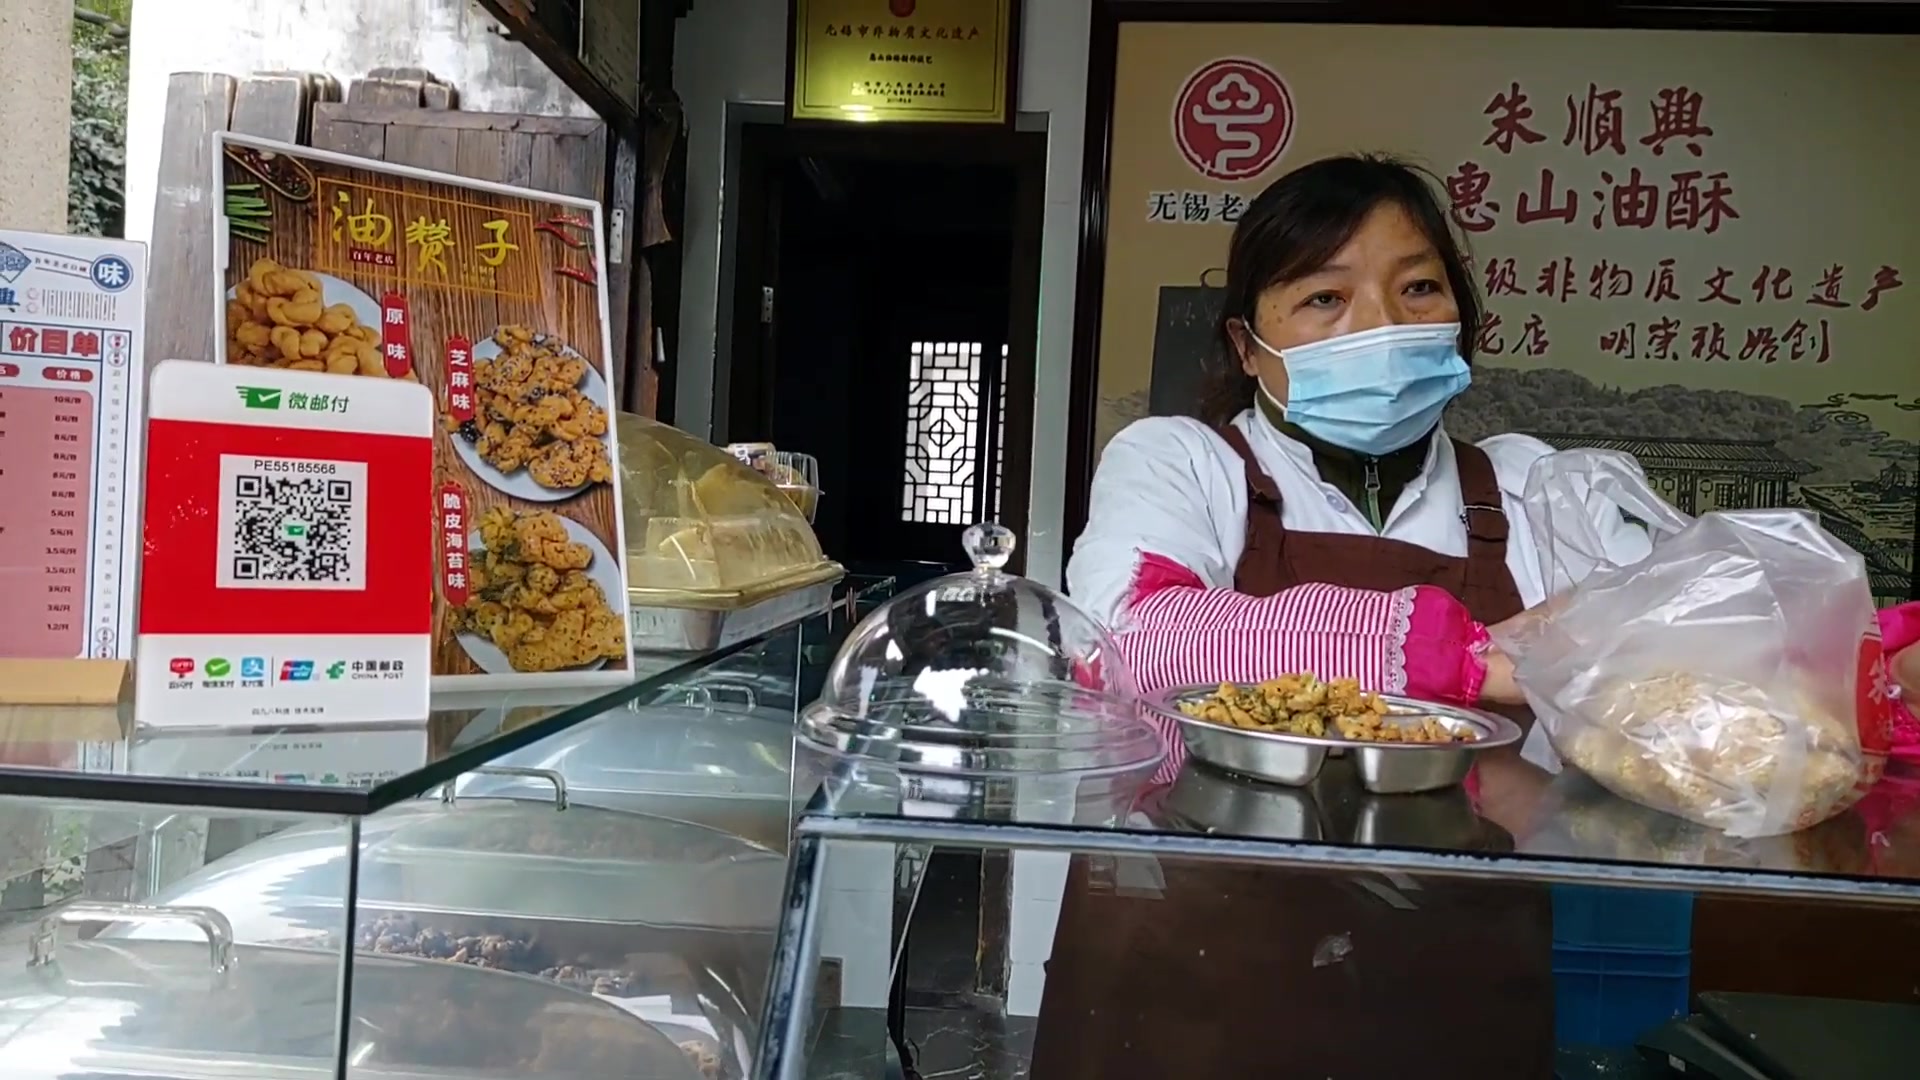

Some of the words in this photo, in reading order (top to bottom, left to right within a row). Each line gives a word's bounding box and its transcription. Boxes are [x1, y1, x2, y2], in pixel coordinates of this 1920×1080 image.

[1149, 190, 1256, 224] 无锡老
[1446, 161, 1741, 234] 惠山油酥
[353, 250, 395, 265] 百年老店
[98, 261, 125, 287] 味
[1461, 256, 1904, 311] 级非物质文化遗产
[9, 325, 100, 357] 价目单
[385, 307, 406, 361] 原味
[56, 369, 81, 381] 价格
[449, 348, 471, 411] 芝麻味
[288, 391, 350, 413] 微邮付
[254, 459, 337, 475] PE55185568
[442, 492, 466, 590] 脆皮海苔味
[351, 660, 404, 672] 中国邮政
[352, 672, 378, 680] CHINA
[383, 672, 404, 680] POST
[241, 680, 265, 688] 支付宝
